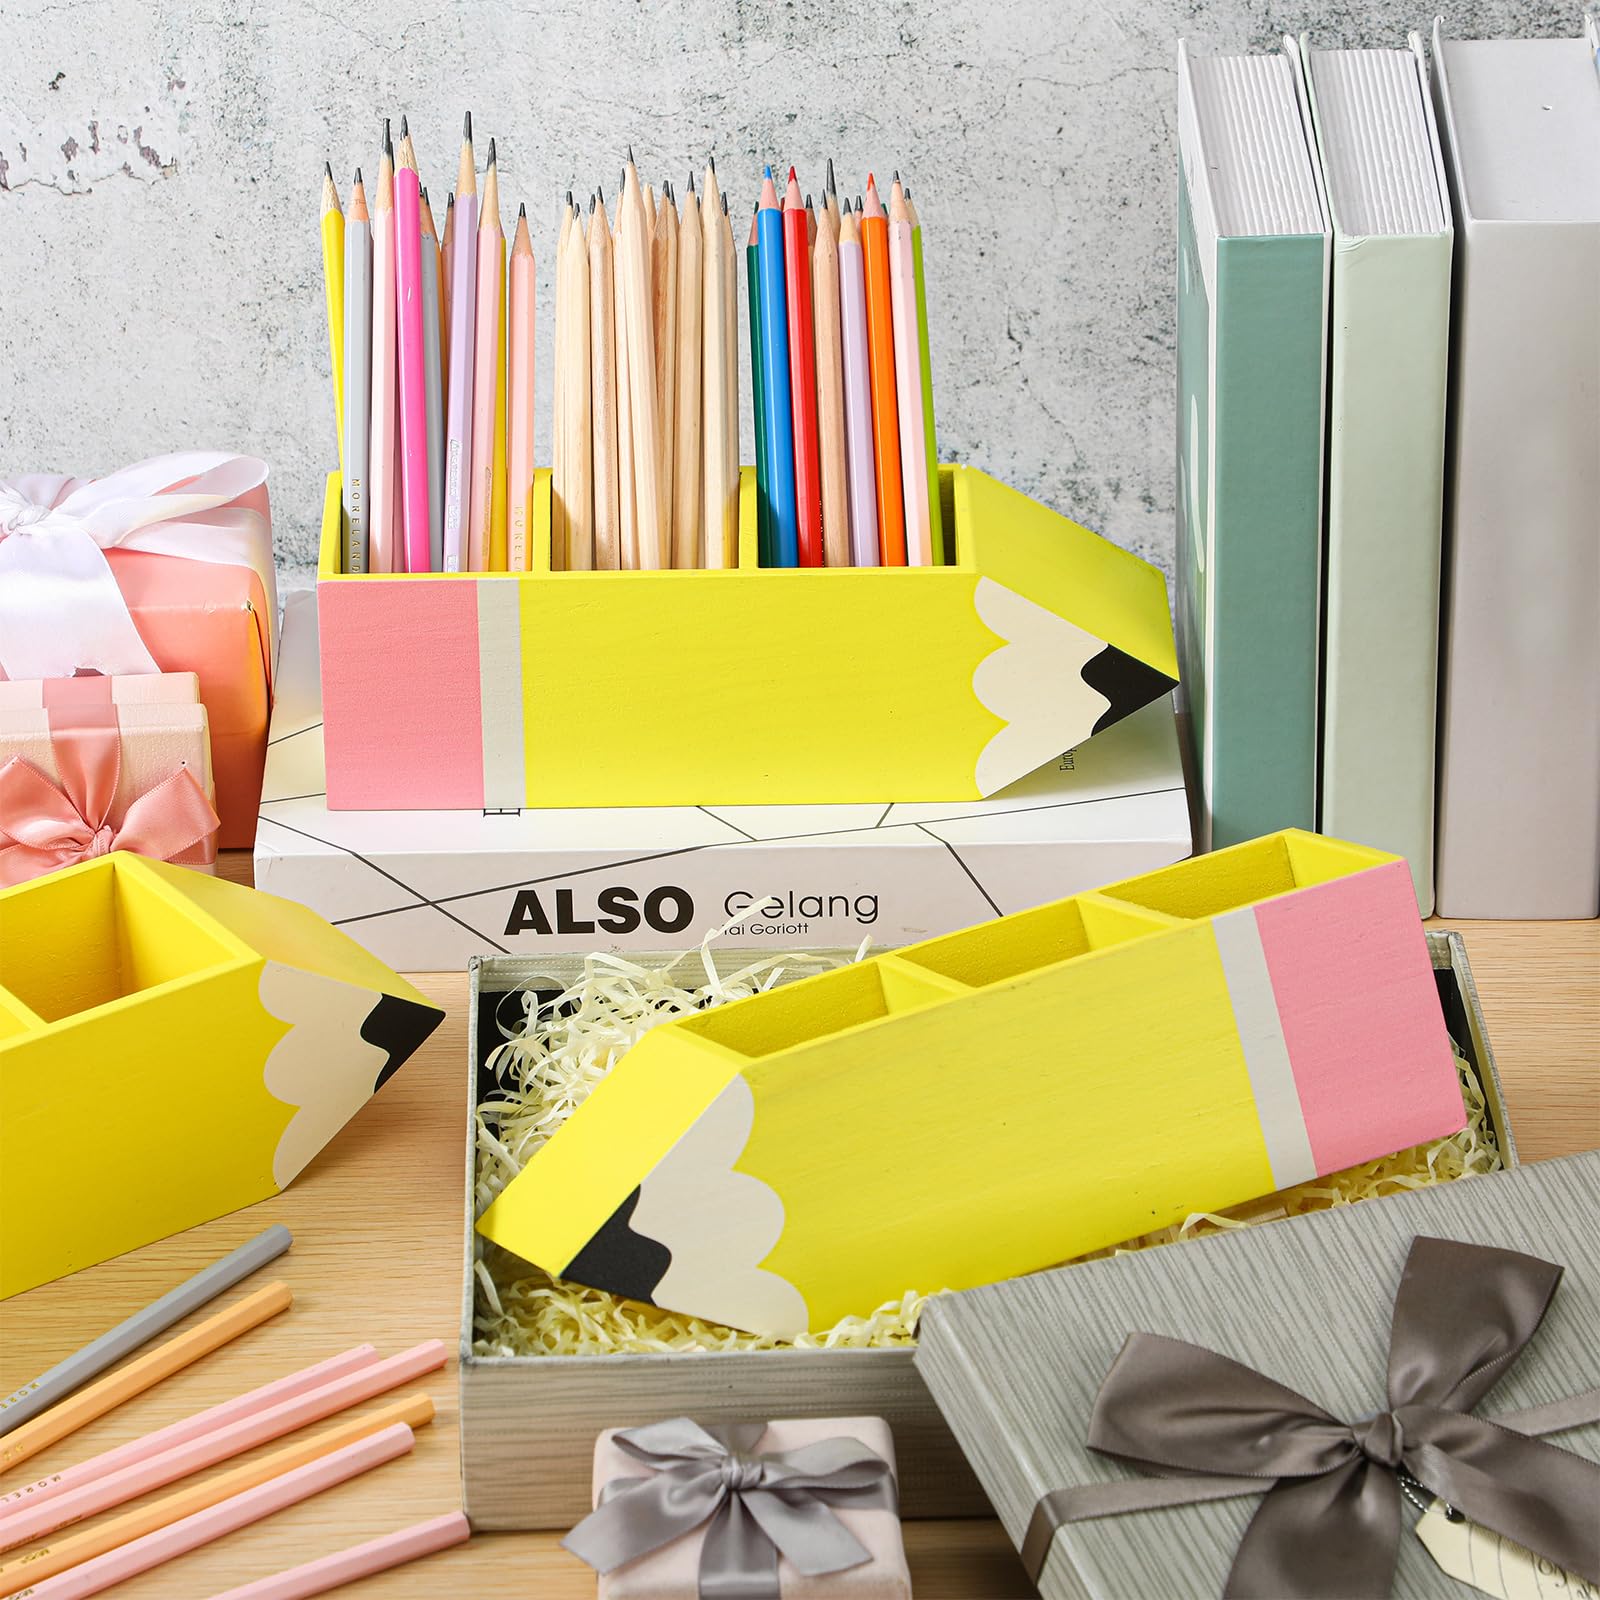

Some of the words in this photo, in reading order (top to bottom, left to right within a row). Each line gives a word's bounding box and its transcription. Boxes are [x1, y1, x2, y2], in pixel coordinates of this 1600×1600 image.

[352, 478, 361, 573] MORELAND
[503, 886, 694, 935] ALSO
[724, 890, 879, 924] Gelang
[750, 922, 809, 936] Goriott
